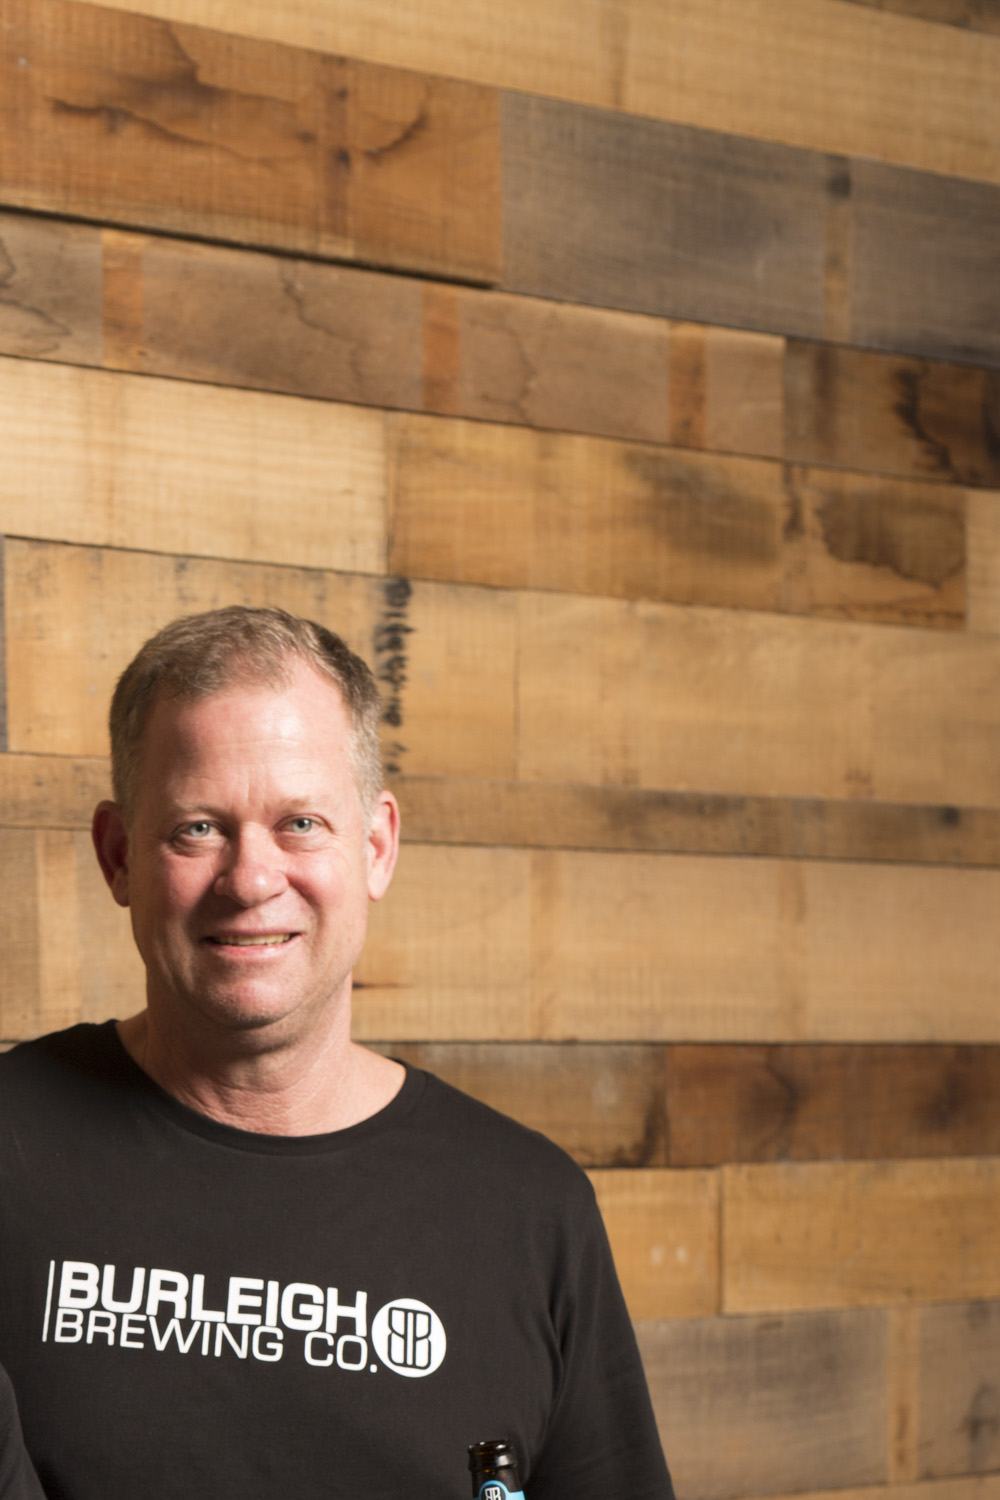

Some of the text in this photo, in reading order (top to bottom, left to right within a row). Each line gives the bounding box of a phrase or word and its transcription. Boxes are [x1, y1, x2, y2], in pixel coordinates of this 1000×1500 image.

[58, 1260, 368, 1337] BURLEIGH
[54, 1307, 378, 1373] BREWING CO.
